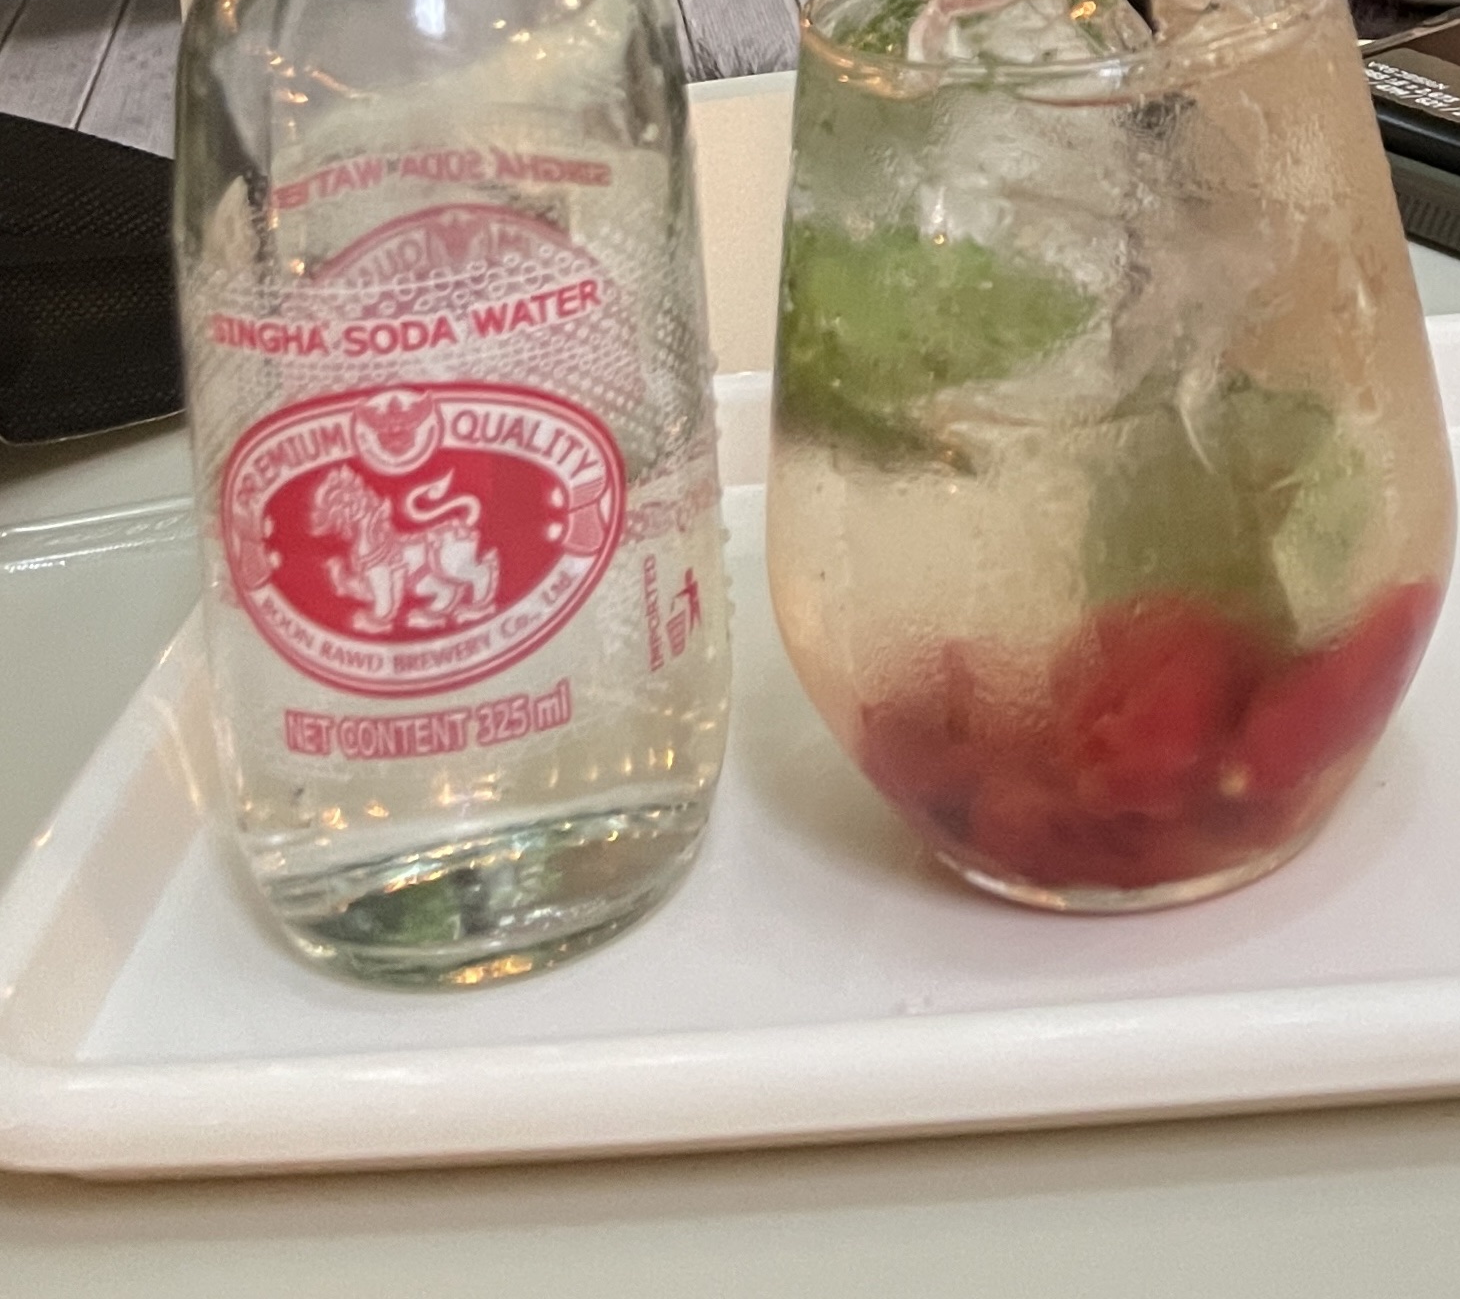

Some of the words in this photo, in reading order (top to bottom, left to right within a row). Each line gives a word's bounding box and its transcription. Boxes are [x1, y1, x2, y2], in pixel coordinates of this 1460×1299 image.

[210, 313, 328, 356] SINGHA
[341, 315, 458, 357] SODA
[469, 278, 600, 339] WATER
[237, 422, 349, 508] PREMIUM
[449, 408, 601, 480] QUALITY
[318, 640, 384, 674] RAWD
[393, 632, 491, 675] BREWERY
[285, 710, 332, 754] NET
[338, 713, 470, 759] CONTENT
[476, 697, 529, 745] 325
[534, 678, 572, 731] ml
